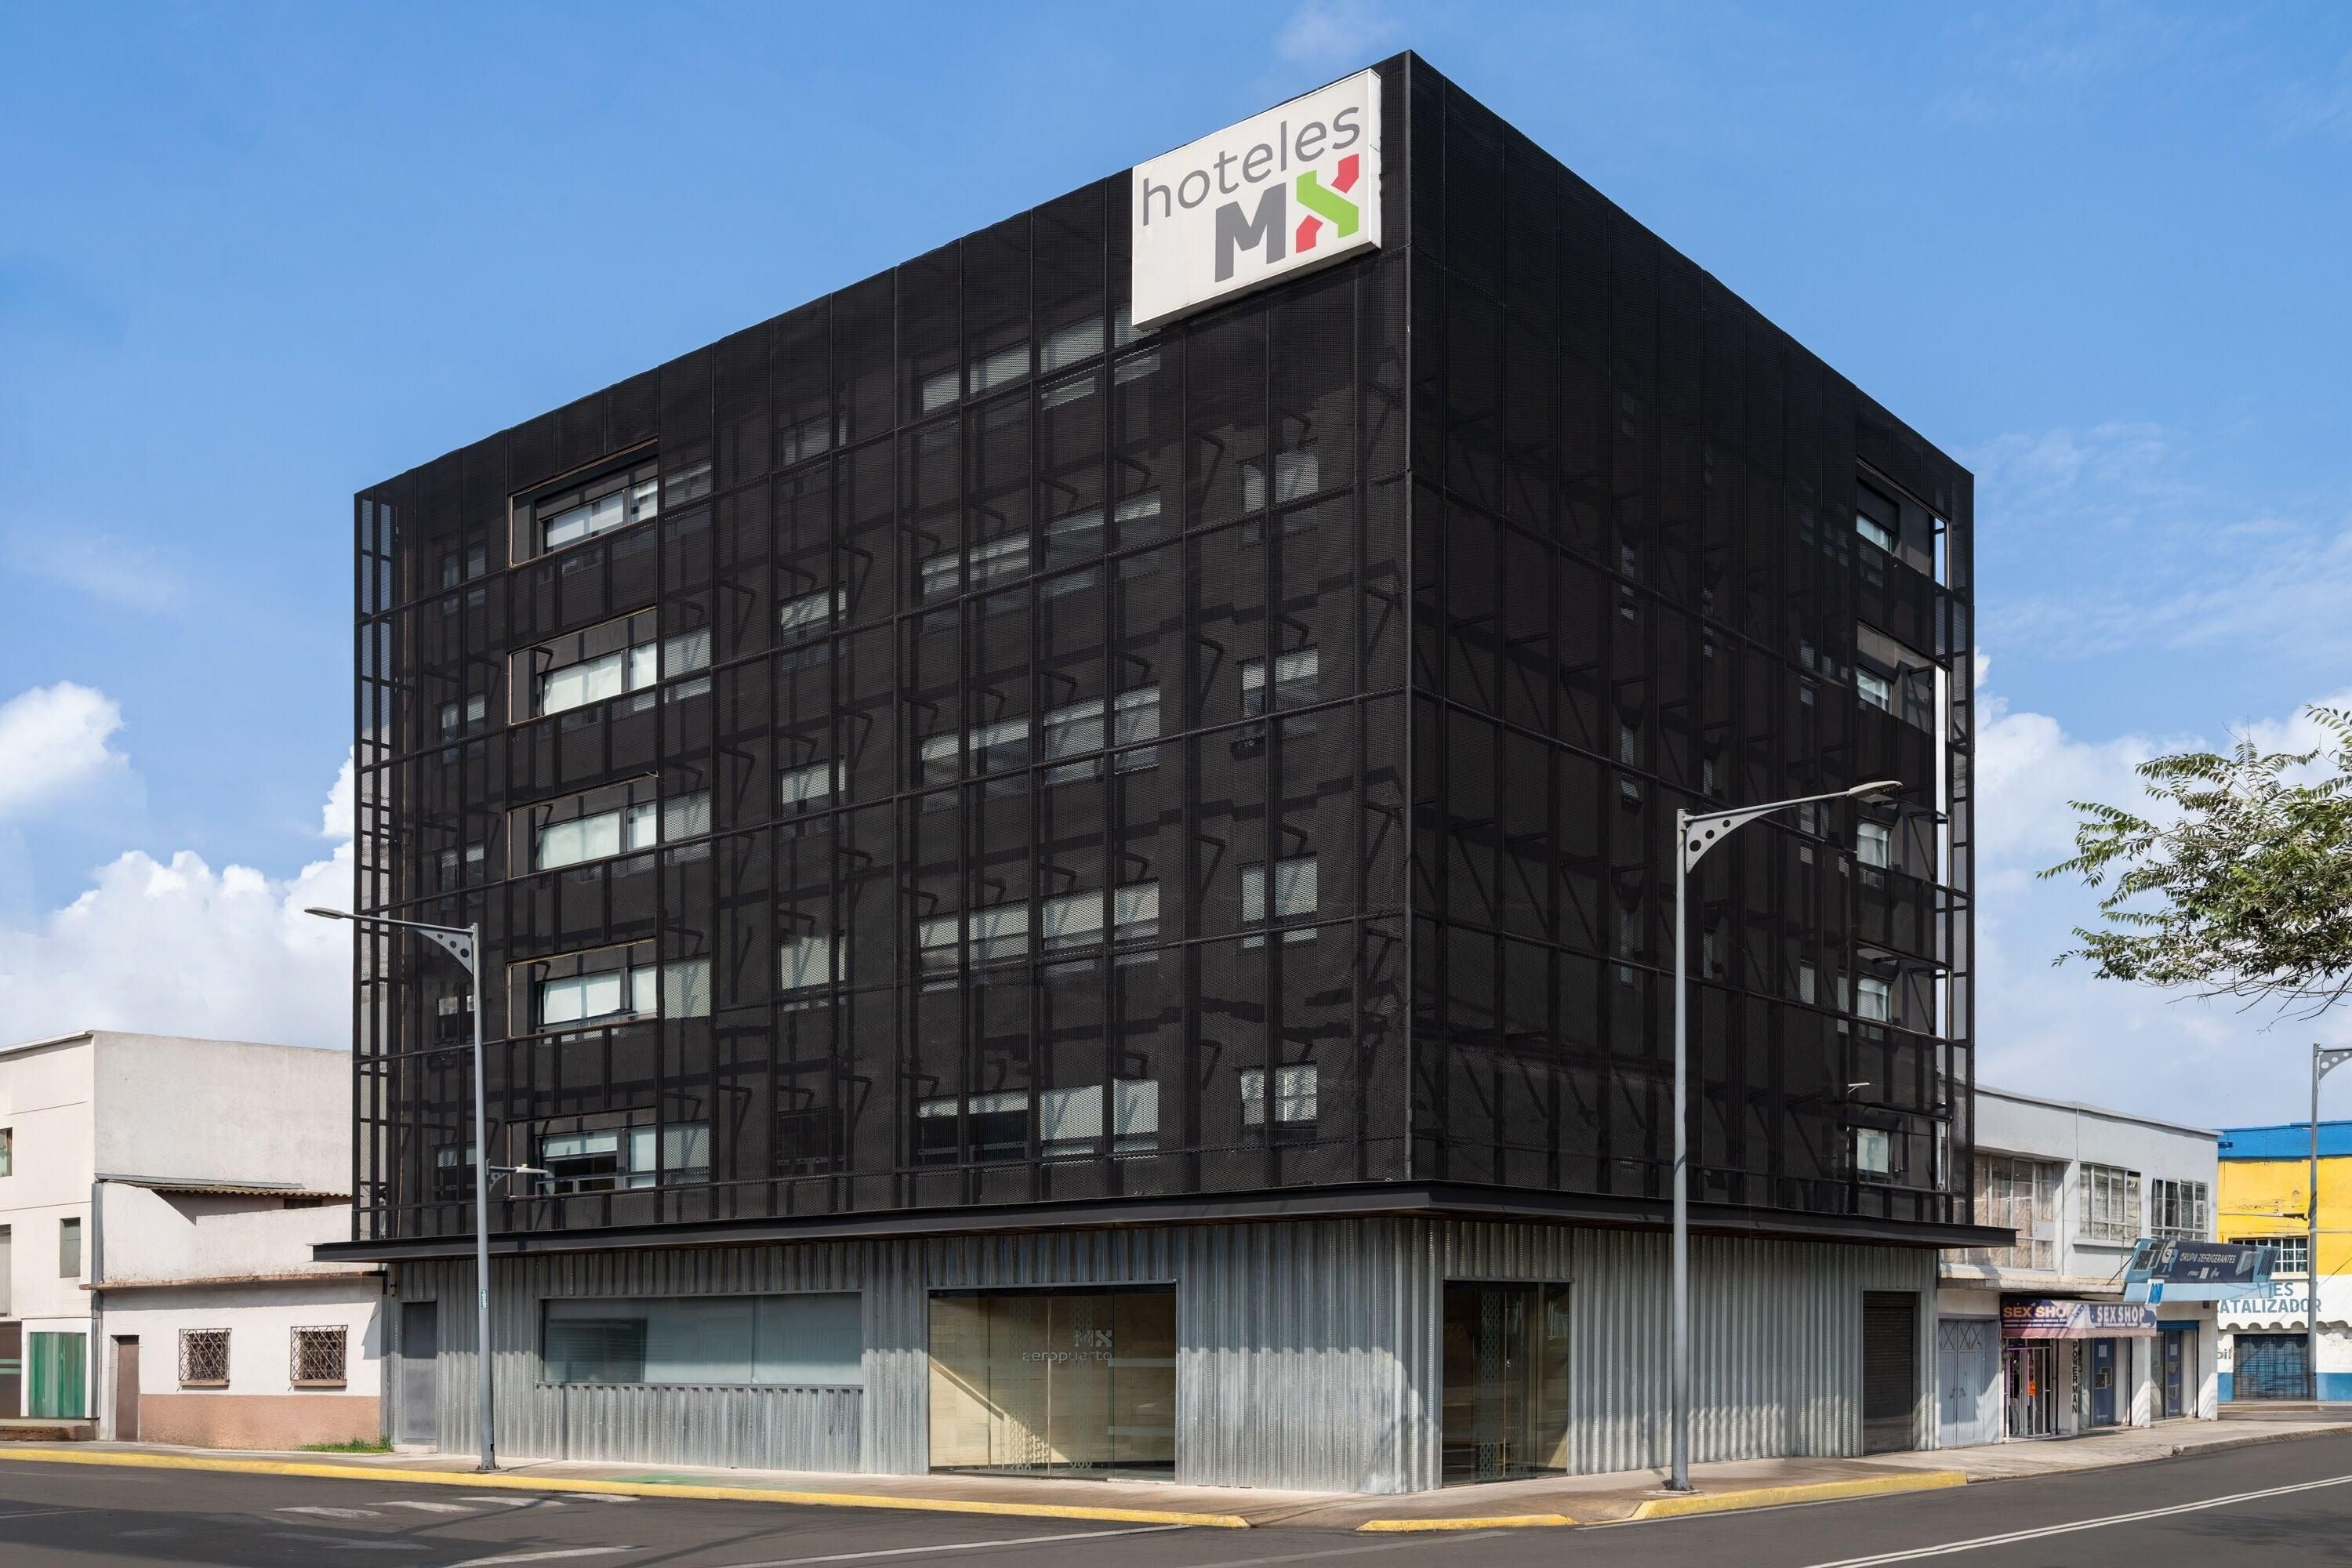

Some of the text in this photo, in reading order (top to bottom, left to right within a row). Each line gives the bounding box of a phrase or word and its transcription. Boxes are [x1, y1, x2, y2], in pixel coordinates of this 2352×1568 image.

[1143, 107, 1360, 227] hoteles
[1215, 153, 1359, 283] MX
[2198, 1253, 2237, 1264] REFRIGERANTES
[2003, 1306, 2032, 1318] SEX
[2096, 1305, 2145, 1323] SEX SHOP
[2218, 1298, 2322, 1314] ATALIZADOR
